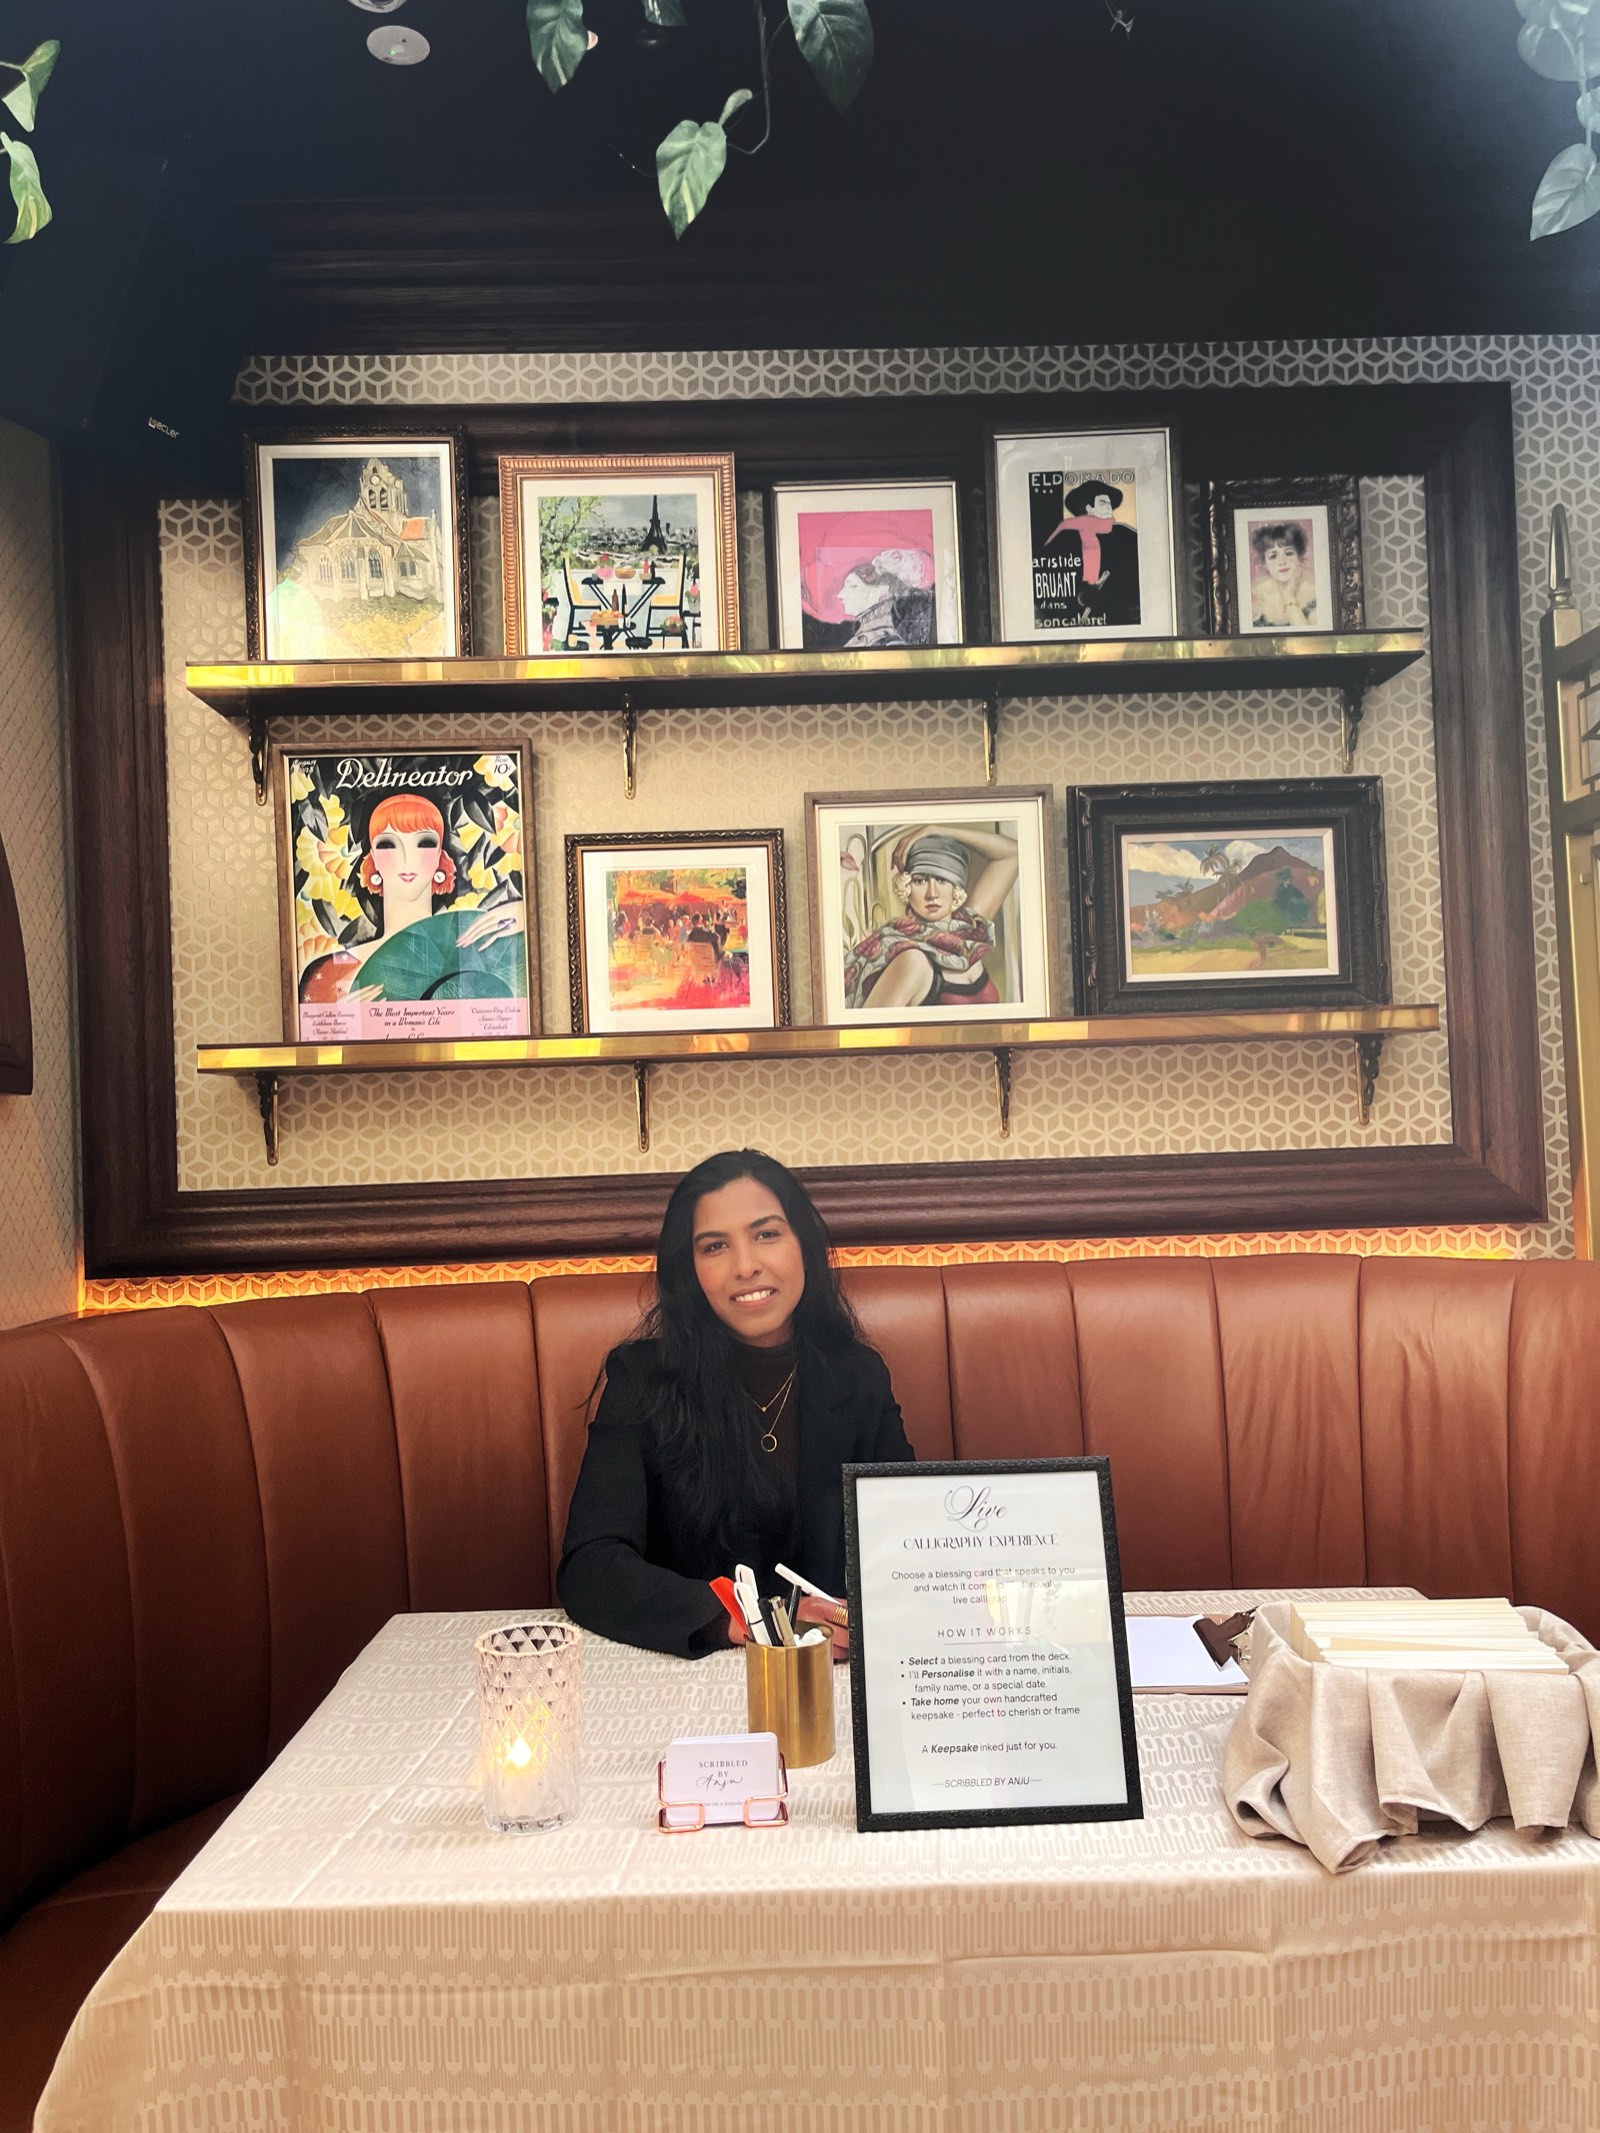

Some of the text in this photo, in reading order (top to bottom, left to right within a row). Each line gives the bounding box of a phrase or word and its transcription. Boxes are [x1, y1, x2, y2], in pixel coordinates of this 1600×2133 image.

[1035, 572, 1077, 598] BRUANT
[1040, 601, 1067, 609] dans
[336, 758, 473, 790] Delineator
[944, 1486, 1007, 1532] Live
[903, 1534, 1059, 1550] CALLIGRAPHY EXPERIENCE
[892, 1570, 926, 1580] Choose
[936, 1570, 972, 1580] blessing
[974, 1568, 993, 1577] card
[996, 1568, 1012, 1576] that
[1014, 1567, 1046, 1576] speaks
[1048, 1566, 1056, 1575] to
[1059, 1567, 1075, 1576] you
[914, 1584, 930, 1592] and
[932, 1582, 958, 1592] watch
[960, 1582, 966, 1591] it
[968, 1583, 992, 1591] com
[952, 1596, 968, 1604] live
[938, 1626, 1032, 1638] HOW IT WORKS
[908, 1656, 938, 1666] Select
[948, 1656, 984, 1665] blessing
[987, 1654, 1006, 1663] card
[1010, 1654, 1029, 1662] from
[1032, 1652, 1046, 1661] the
[1048, 1652, 1072, 1660] deck.
[922, 1669, 974, 1678] Personalise
[977, 1668, 982, 1676] it
[985, 1668, 1003, 1676] with
[1006, 1668, 1010, 1676] a
[1013, 1667, 1040, 1676] name,
[1042, 1666, 1072, 1674] initials,
[914, 1684, 940, 1694] family
[944, 1684, 970, 1692] name,
[992, 1680, 1024, 1690] special
[910, 1693, 1058, 1707] Take home your own handcrafted
[911, 1711, 954, 1721] keepsake
[962, 1708, 994, 1720] perfect
[997, 1708, 1006, 1717] to
[1008, 1707, 1040, 1716] cherish
[1054, 1706, 1080, 1714] frame
[922, 1741, 1058, 1754] A Keepsake inked just for you.
[699, 1760, 748, 1768] SCRIBBLED
[944, 1776, 1030, 1788] SCRIBBLED BY ANJU
